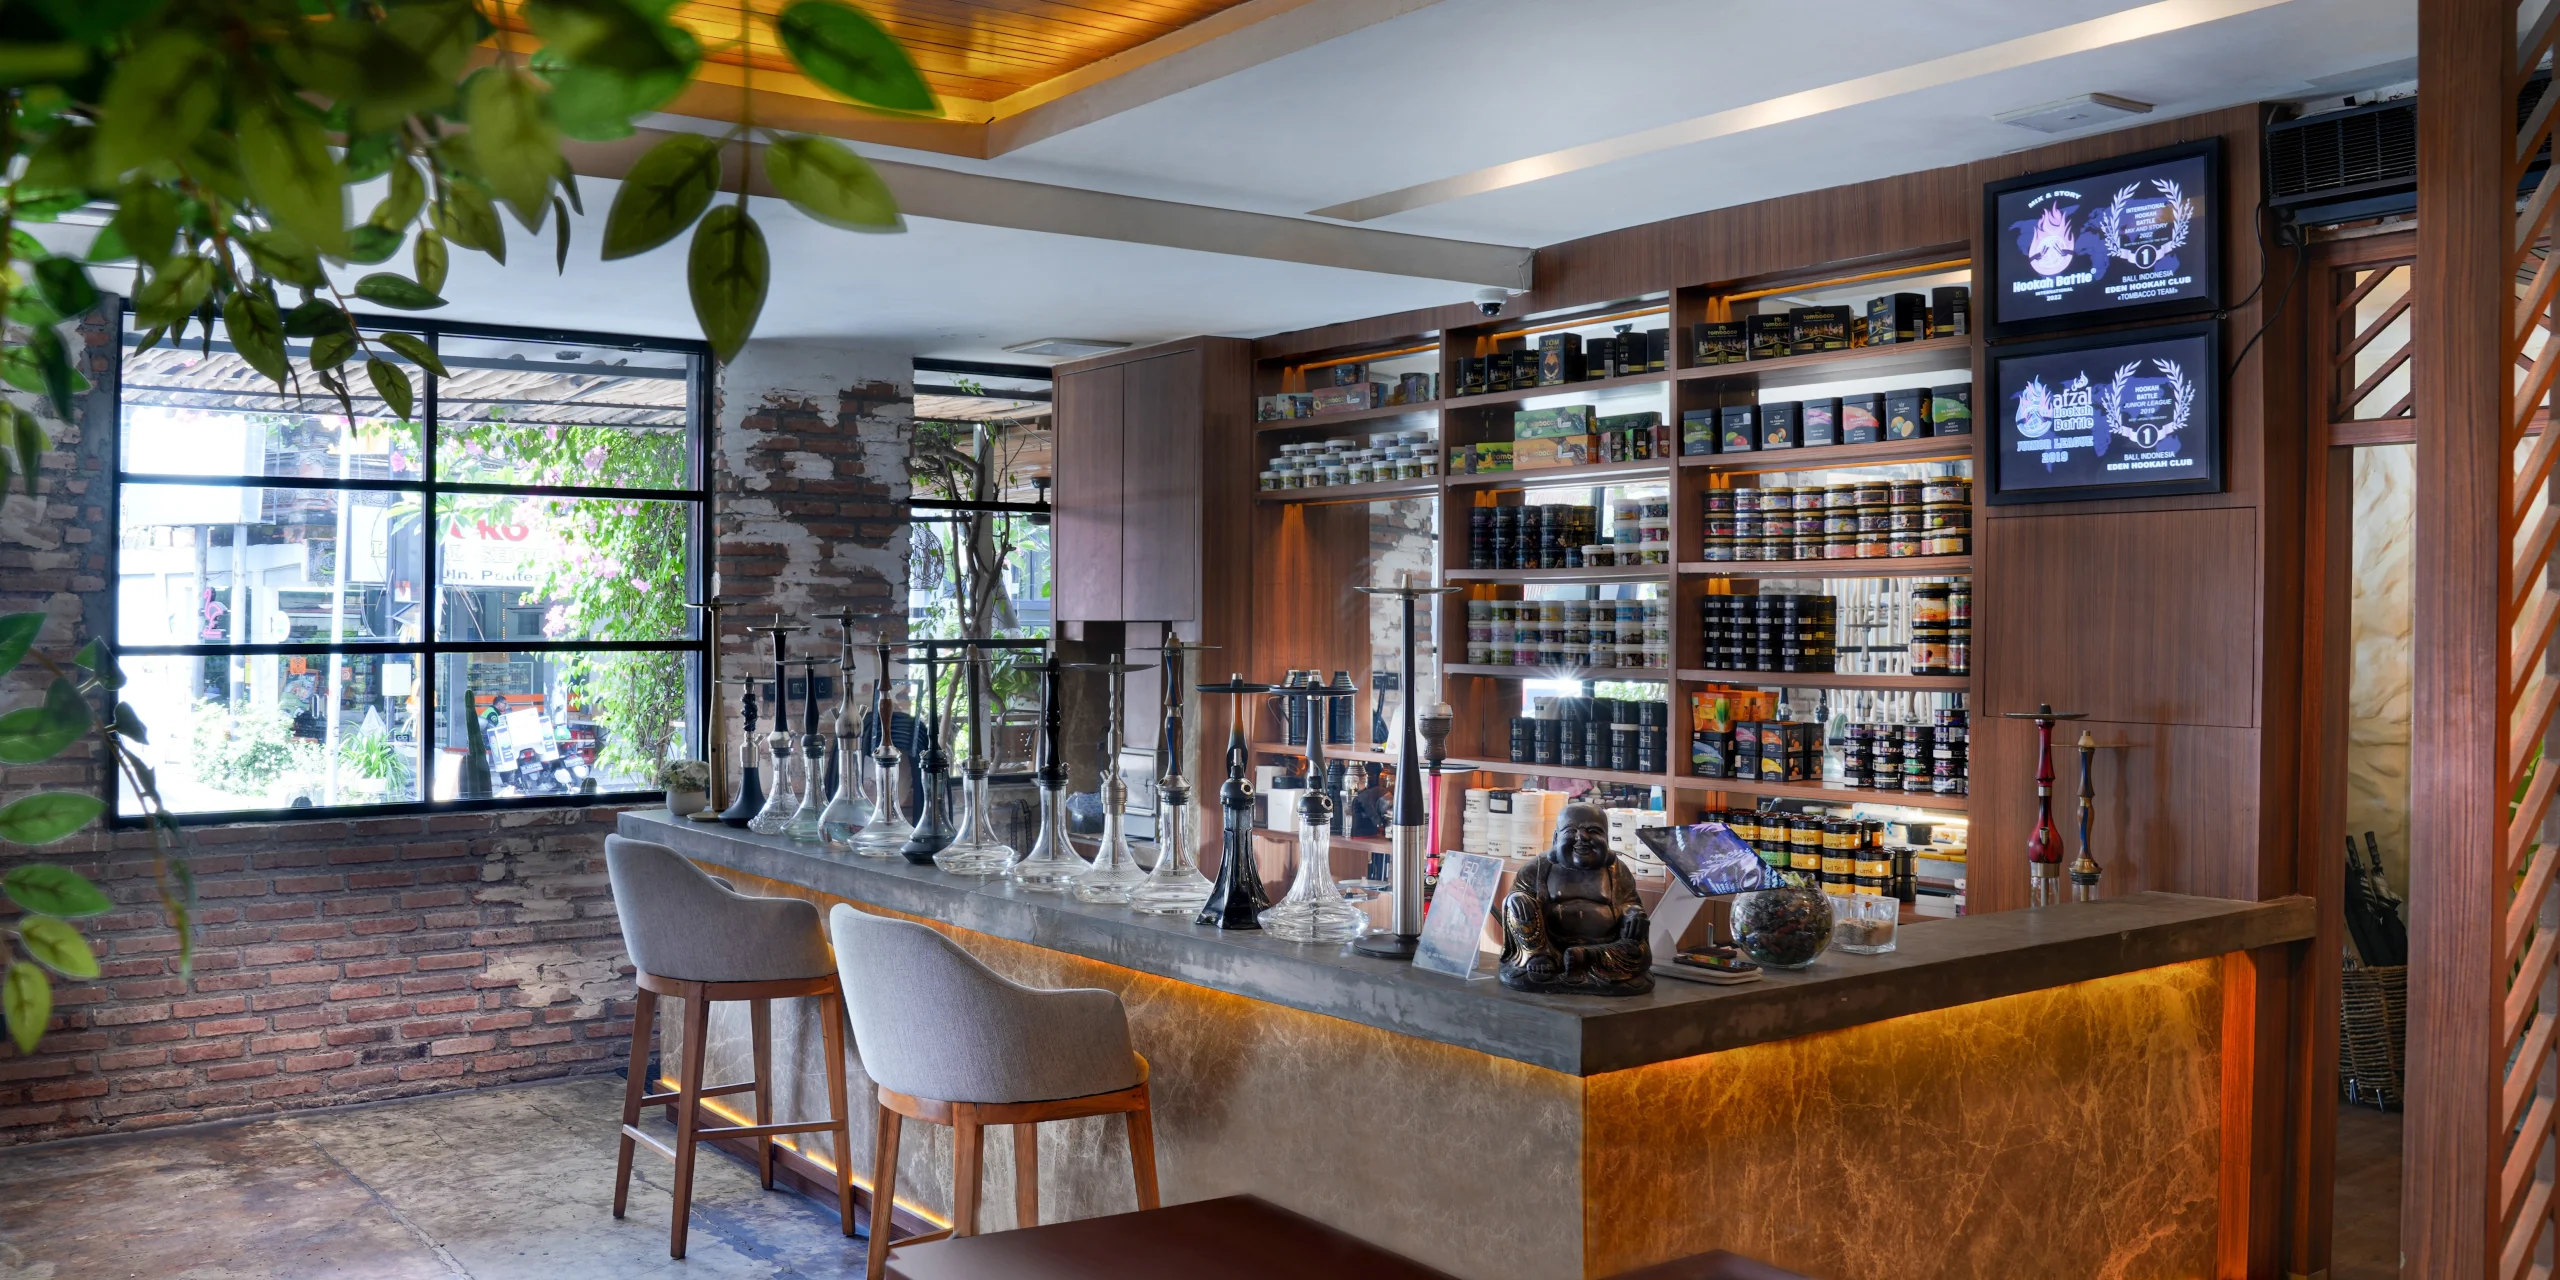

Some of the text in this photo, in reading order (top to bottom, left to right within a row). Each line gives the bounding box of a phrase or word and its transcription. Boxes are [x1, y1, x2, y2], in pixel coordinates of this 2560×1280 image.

[2028, 196, 2044, 208] MIX
[2054, 190, 2082, 200] STORY
[2126, 202, 2166, 214] INTERNATIONAL
[2135, 211, 2157, 219] HOOKAH
[2136, 218, 2156, 226] BATTLE
[2141, 249, 2149, 265] 1
[2013, 272, 2092, 293] Hookah Battle
[2122, 270, 2174, 283] BALI, INDONESIA
[2035, 287, 2073, 296] INTERNATIONAL
[2105, 276, 2192, 294] EDEN HOOKAH CLUB
[2135, 385, 2159, 393] HOOKAH
[2053, 386, 2092, 408] afzal
[2136, 392, 2158, 400] BATTLE
[2054, 405, 2093, 418] Hookah
[2054, 417, 2094, 432] Battle
[2143, 428, 2151, 444] 1
[2017, 436, 2094, 452] JUNIOR LEAGUE
[2042, 451, 2068, 463] 2019
[2141, 451, 2175, 460] INDONESIA
[2107, 458, 2193, 471] EDEN HOOKAH CLUB
